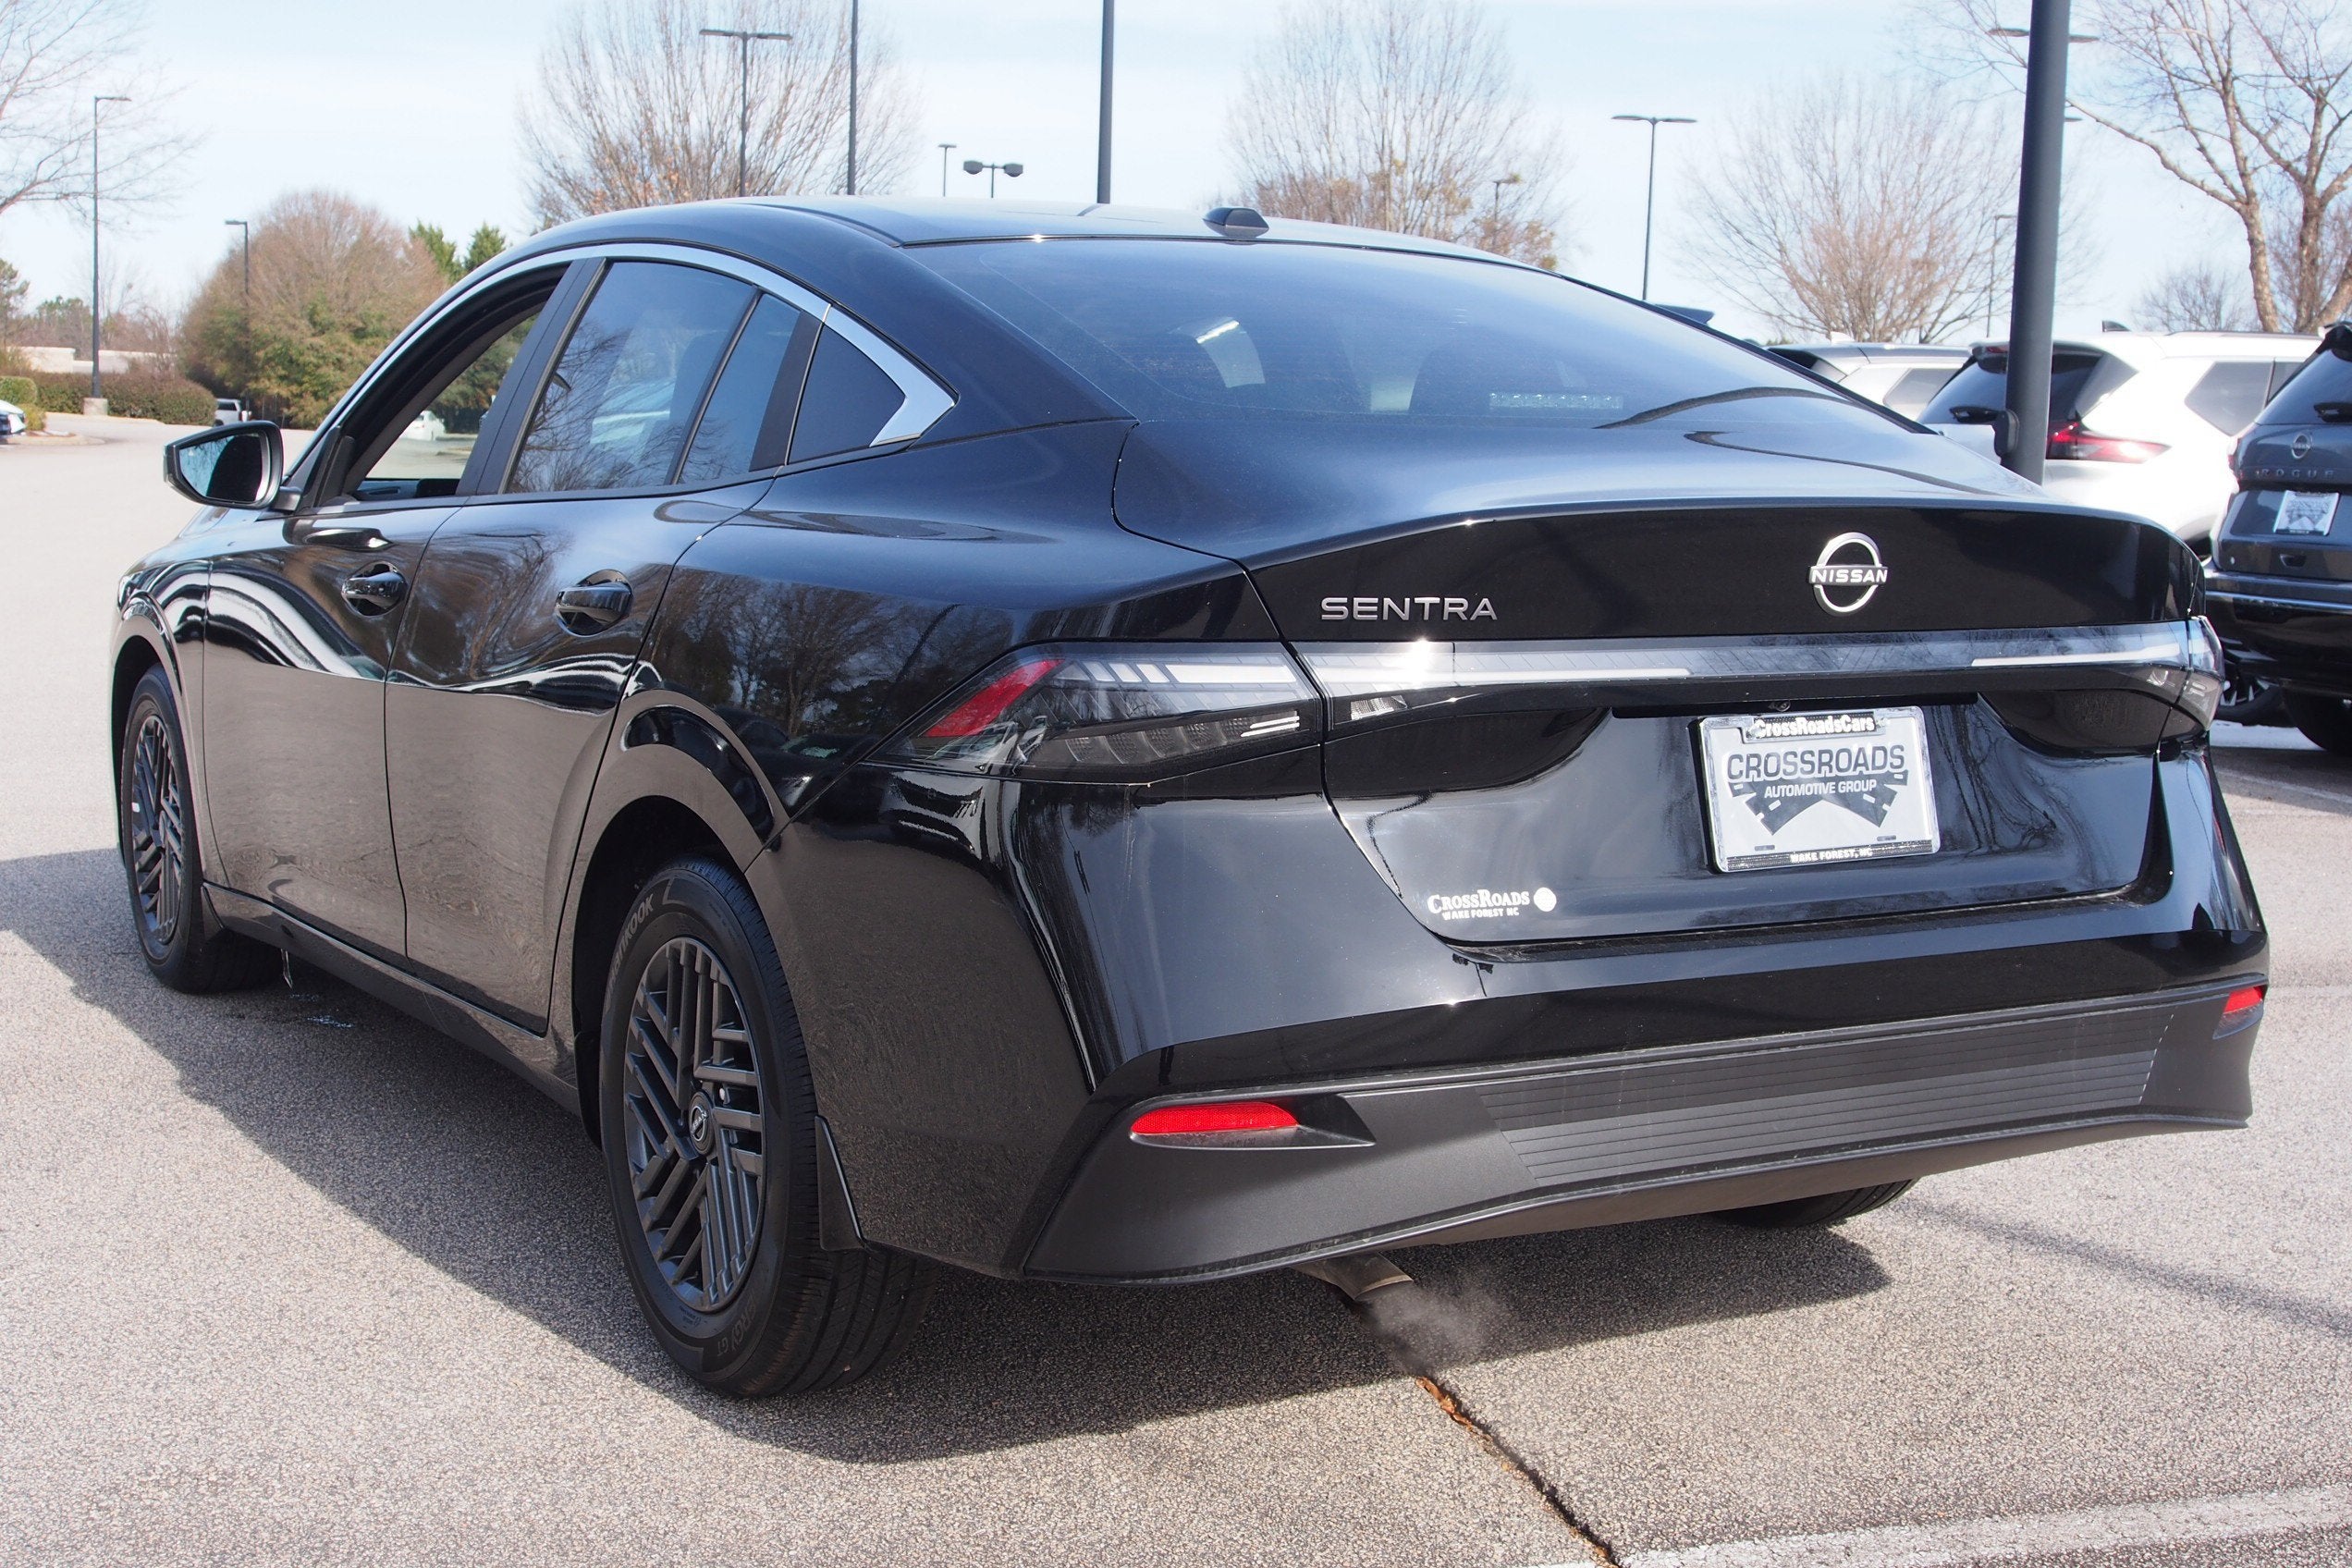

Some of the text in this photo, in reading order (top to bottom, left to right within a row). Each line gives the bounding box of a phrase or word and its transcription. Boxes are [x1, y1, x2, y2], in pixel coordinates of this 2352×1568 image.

[1811, 569, 1888, 583] NISSAN
[1320, 596, 1498, 621] SENTRA
[1755, 714, 1875, 739] CrossRoadsCars
[1727, 744, 1905, 780] CROSSROADS
[1764, 778, 1877, 799] AUTOMOTIVE GROUP
[1442, 907, 1520, 921] WAKE FOREST NC
